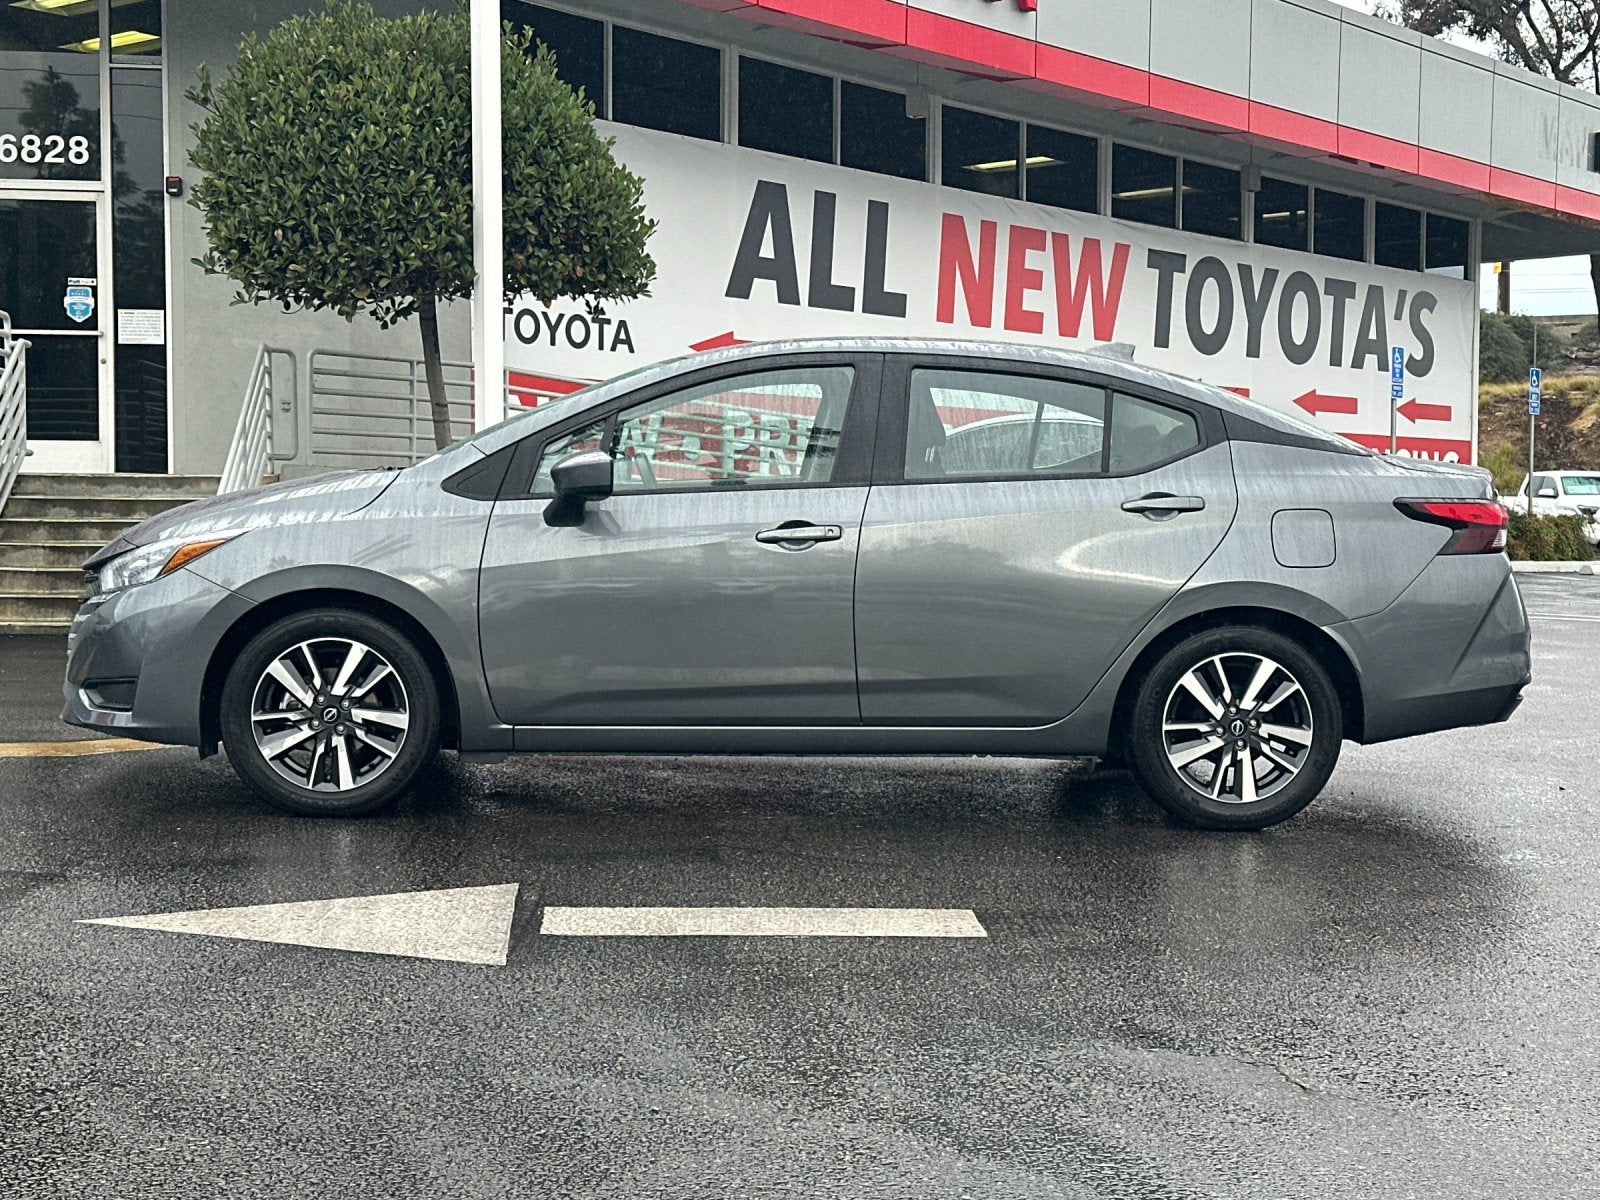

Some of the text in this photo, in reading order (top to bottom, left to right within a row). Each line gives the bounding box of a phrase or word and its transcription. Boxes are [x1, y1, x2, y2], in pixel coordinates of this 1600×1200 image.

[0, 133, 89, 164] 6828
[725, 180, 1438, 378] ALL NEW TOYOTA'S
